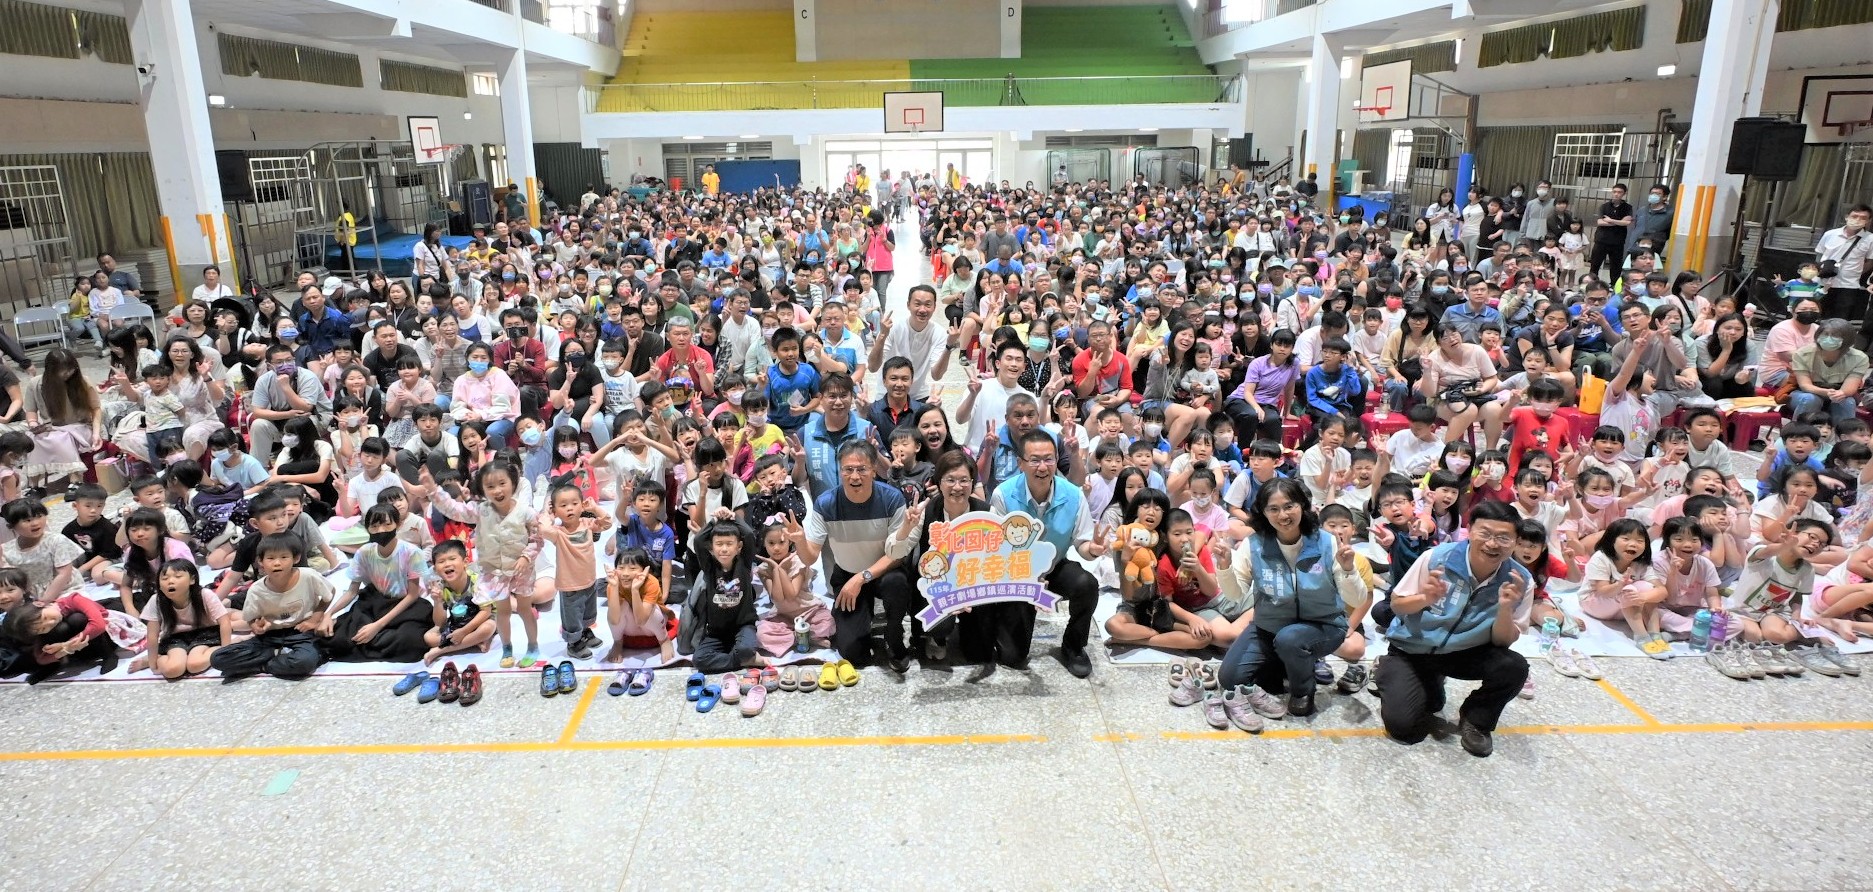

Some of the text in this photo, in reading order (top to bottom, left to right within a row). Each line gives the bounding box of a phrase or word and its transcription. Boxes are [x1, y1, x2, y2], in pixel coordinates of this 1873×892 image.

[801, 9, 808, 19] C
[1007, 7, 1015, 17] D
[956, 550, 1031, 587] 好幸福
[929, 585, 951, 594] 115年
[937, 586, 1037, 608] 親子劇場鄉鎮巡演活動
